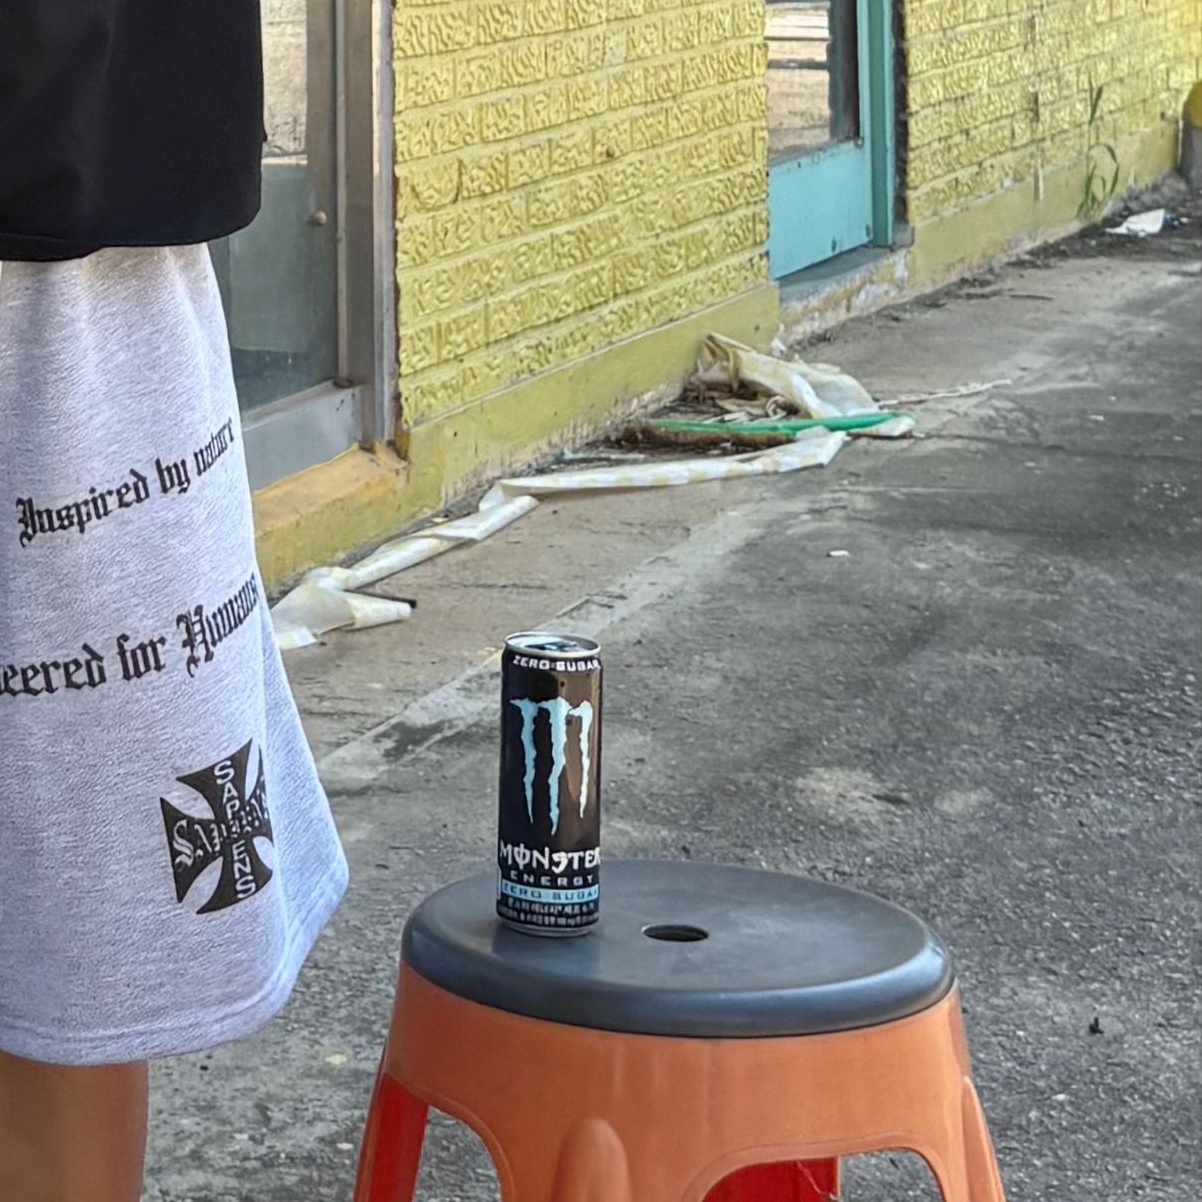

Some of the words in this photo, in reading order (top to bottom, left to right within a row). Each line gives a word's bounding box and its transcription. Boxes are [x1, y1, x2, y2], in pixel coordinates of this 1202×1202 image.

[15, 468, 150, 548] Inspired
[154, 457, 190, 494] by
[194, 417, 235, 477] natur
[116, 632, 167, 681] for
[513, 655, 550, 670] ZERO
[510, 870, 593, 887] ENERGY
[503, 882, 542, 899] ZERO
